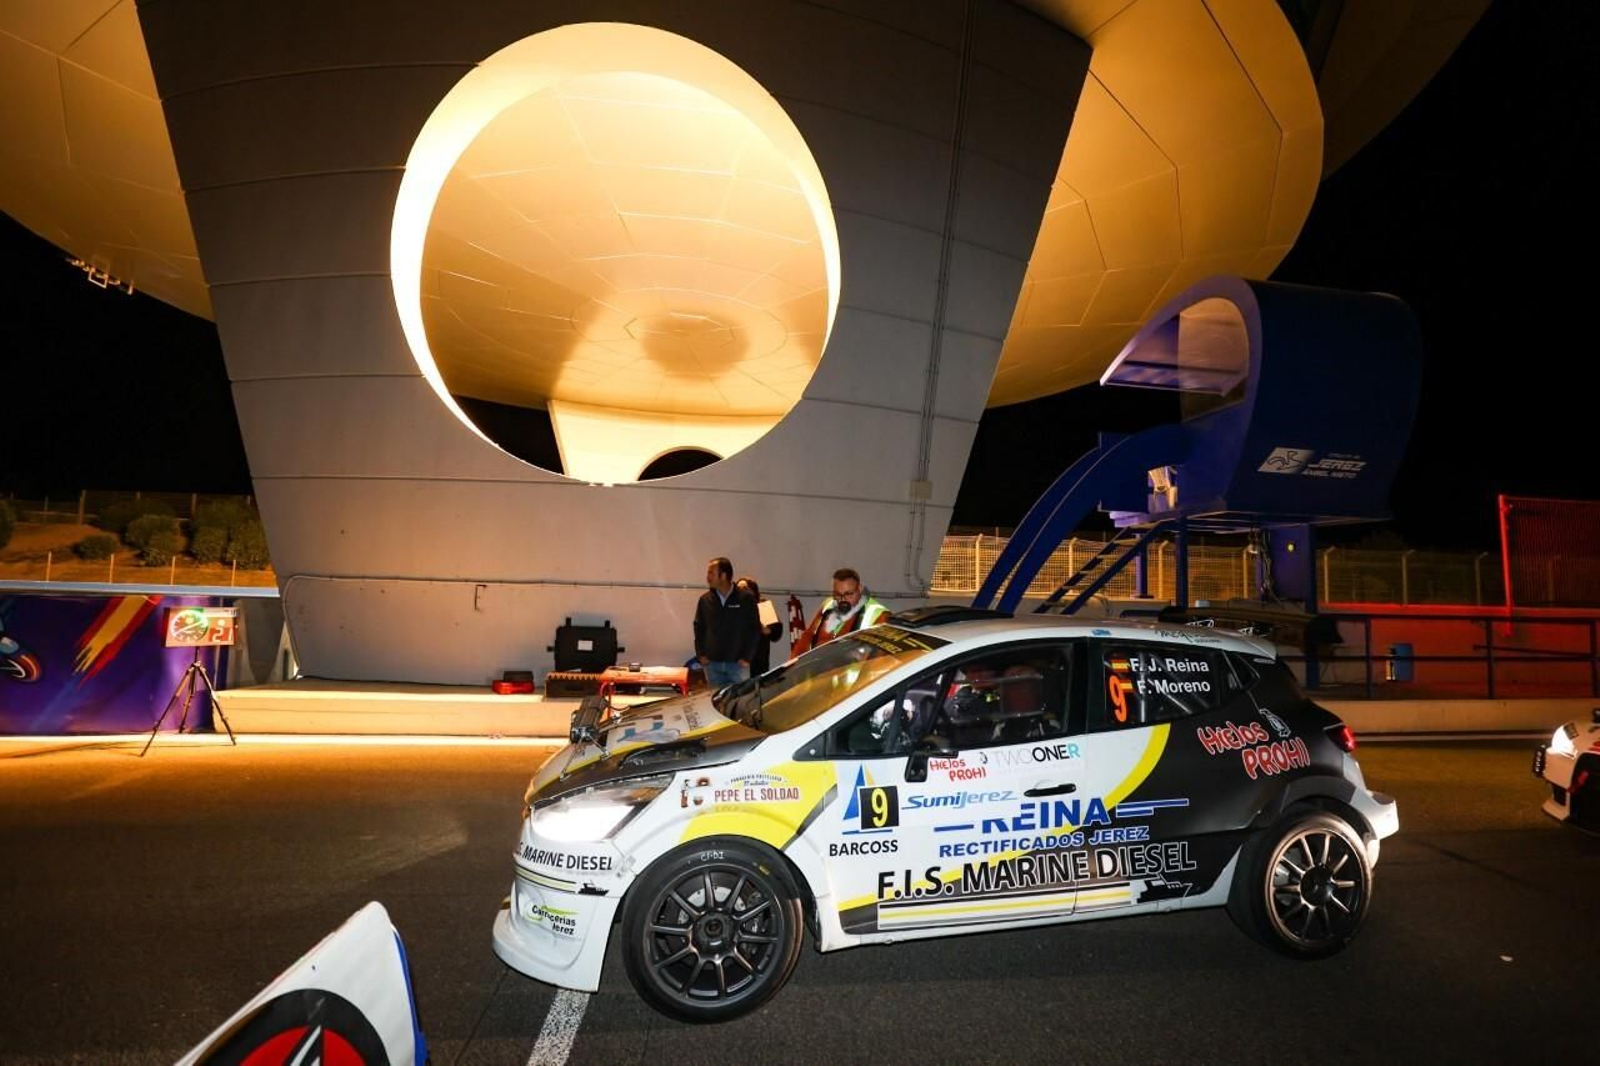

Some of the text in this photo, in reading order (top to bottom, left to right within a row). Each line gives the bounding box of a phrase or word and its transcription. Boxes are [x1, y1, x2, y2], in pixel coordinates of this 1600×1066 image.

[1166, 658, 1210, 672] Reina
[1156, 679, 1211, 694] Moreno
[1109, 675, 1127, 722] 9
[714, 786, 800, 802] PEPE EL SOLDAD
[871, 788, 889, 828] 9
[829, 839, 898, 857] BARCOSS
[938, 826, 1150, 858] RECTIFICADOS JEREZ
[522, 845, 564, 868] MARINE
[877, 842, 1197, 899] F.I.S. MARINE DIESEL
